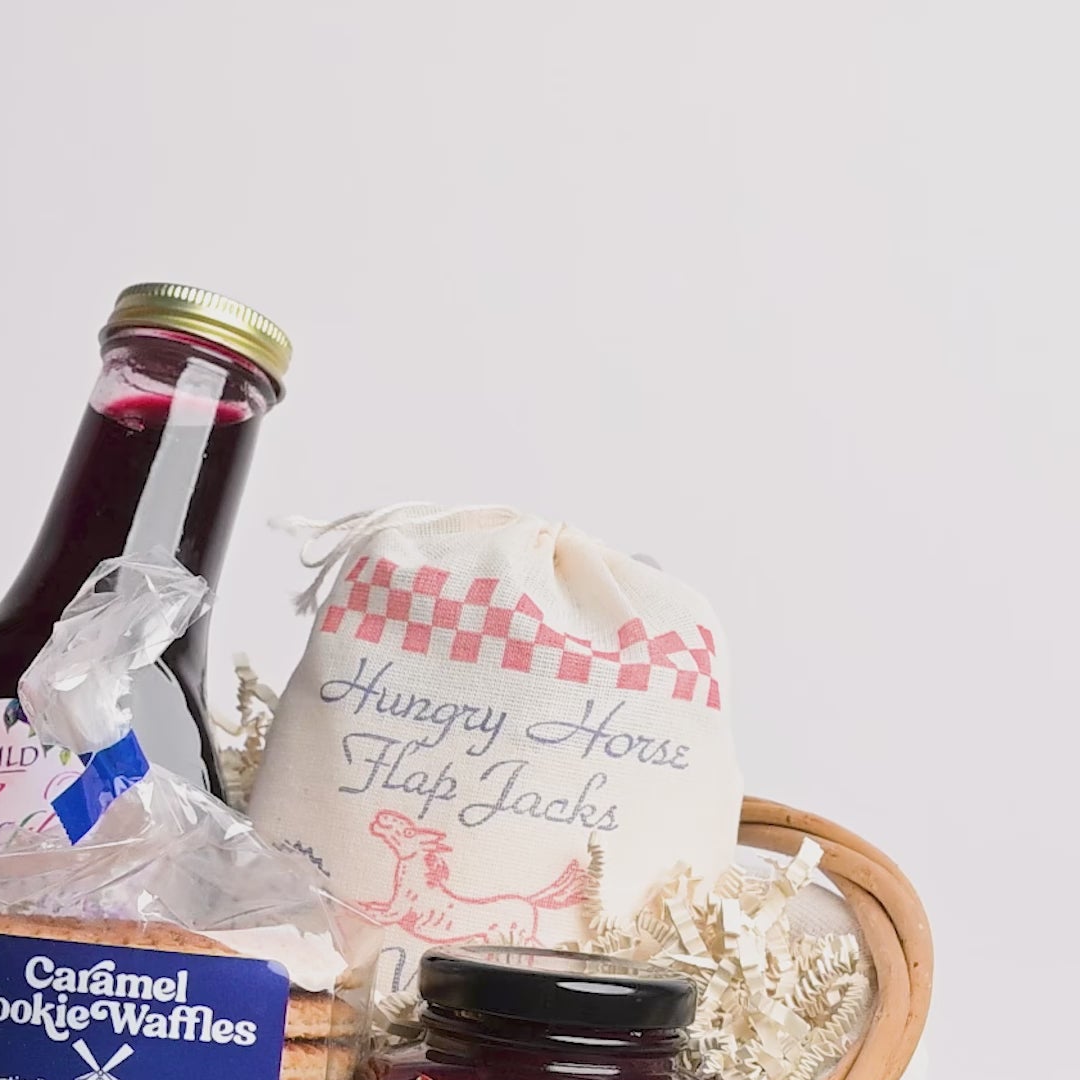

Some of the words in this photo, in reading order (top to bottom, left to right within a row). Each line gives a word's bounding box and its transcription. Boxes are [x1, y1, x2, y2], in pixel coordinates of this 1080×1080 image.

[320, 657, 507, 756] Hungry
[525, 698, 690, 770] Horse
[338, 732, 457, 819] Flap
[458, 759, 619, 831] Jacks
[25, 955, 189, 1003] Caramel
[89, 1000, 258, 1046] Waffles
